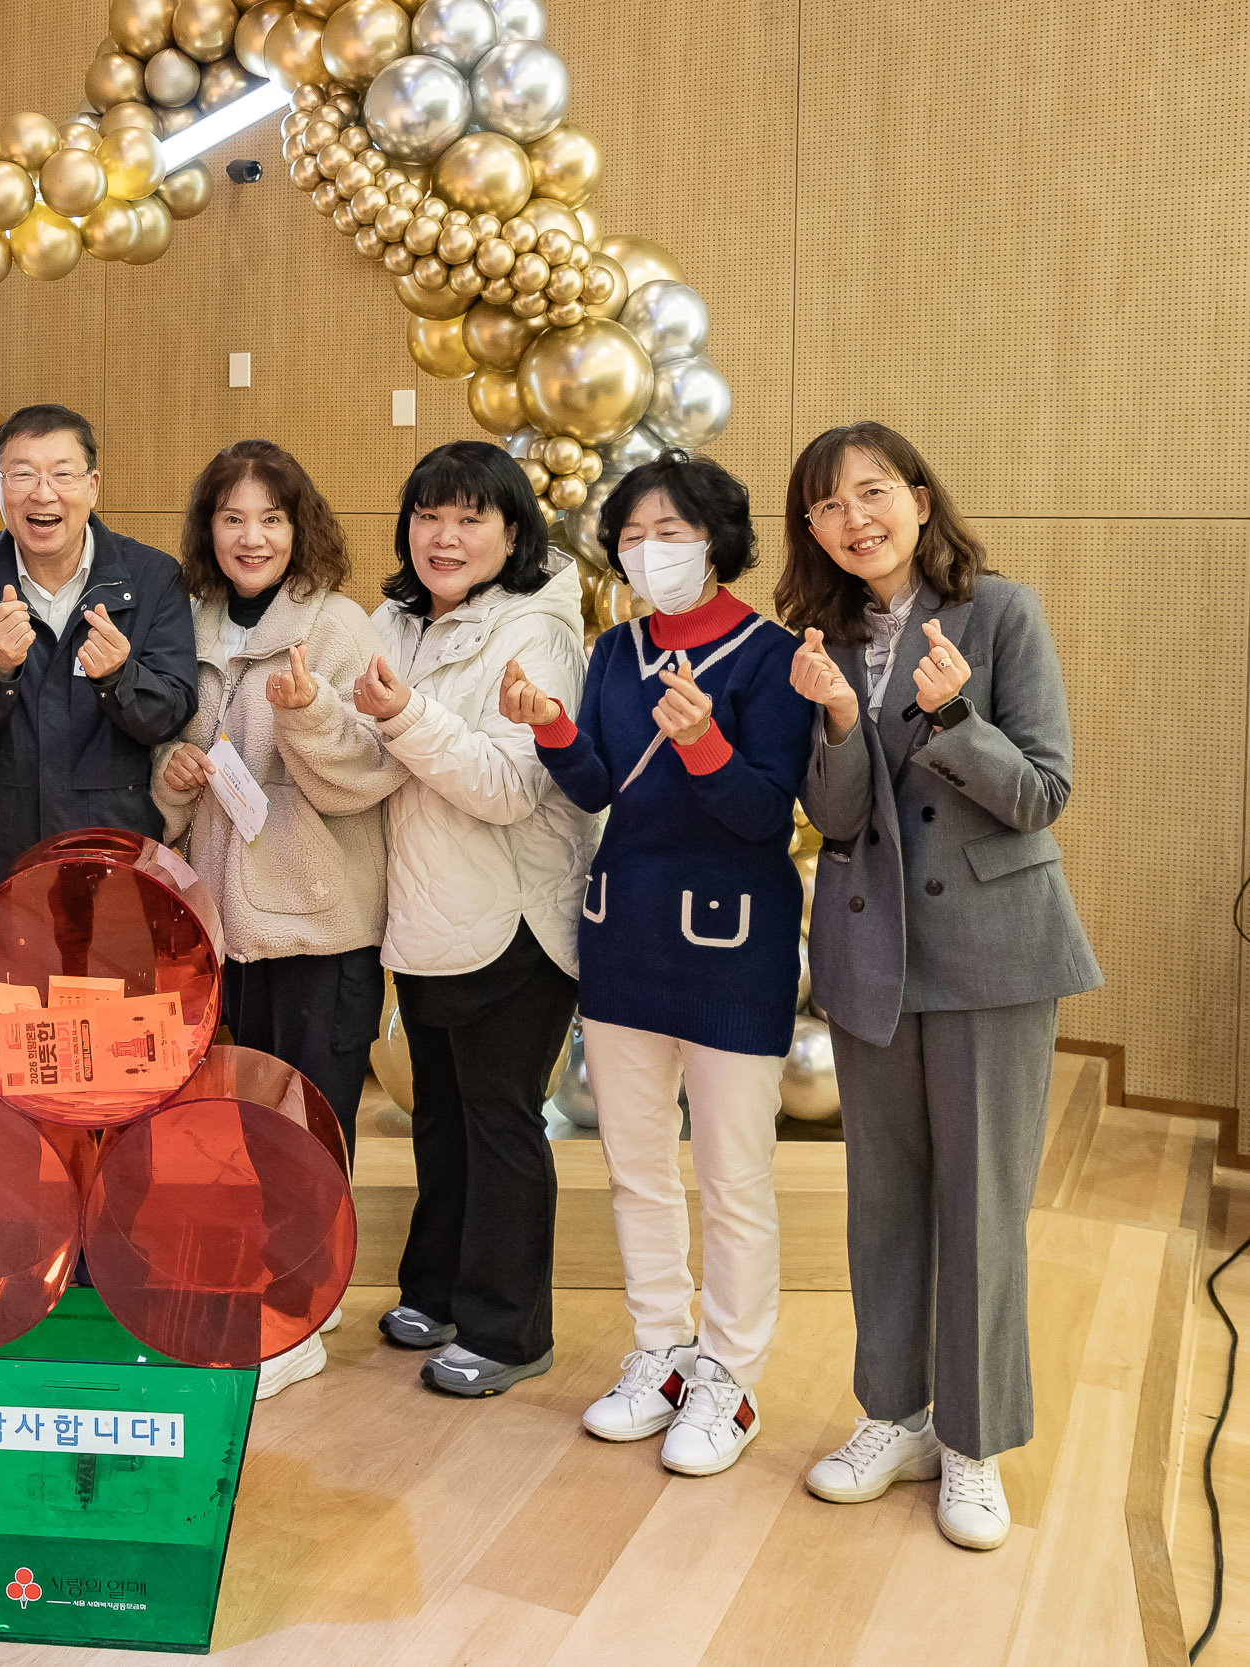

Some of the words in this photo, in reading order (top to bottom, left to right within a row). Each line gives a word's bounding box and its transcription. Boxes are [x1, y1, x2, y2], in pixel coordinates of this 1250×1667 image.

[29, 1061, 39, 1085] 2026
[36, 1021, 58, 1085] 따뜻한
[56, 1021, 73, 1084] 겨울나기
